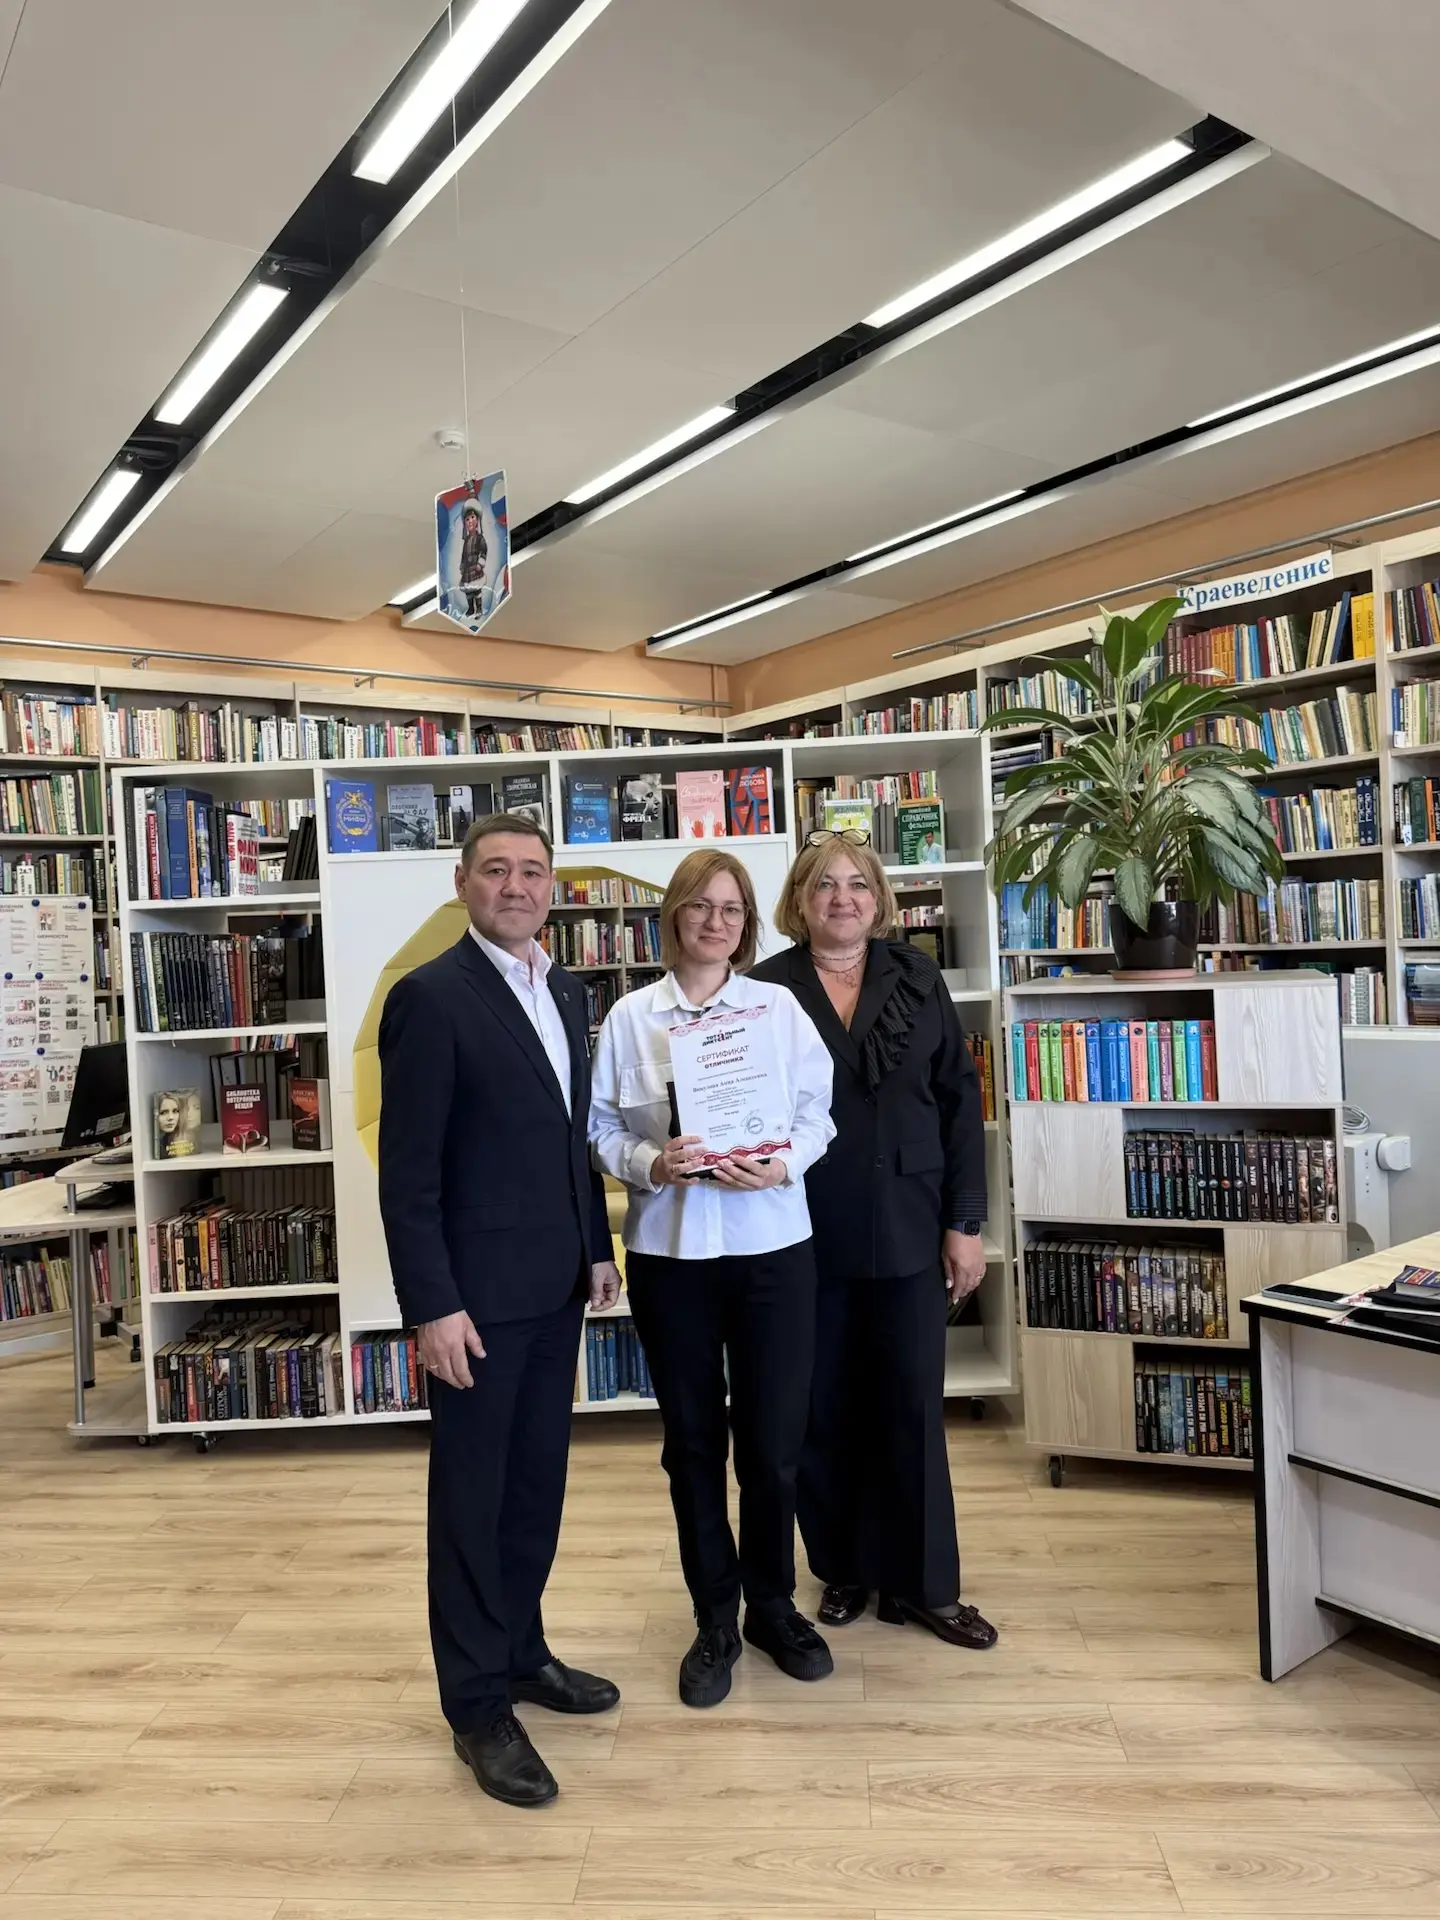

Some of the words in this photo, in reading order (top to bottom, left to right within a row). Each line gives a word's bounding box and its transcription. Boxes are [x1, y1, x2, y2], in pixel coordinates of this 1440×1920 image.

[1179, 557, 1331, 611] Краеведение
[902, 813, 938, 822] СПРАВОЧНИК
[237, 839, 257, 856] ФЛАГИ
[239, 856, 257, 876] МИРА
[697, 1045, 750, 1063] СЕРТИФИКАТ
[704, 1056, 744, 1069] отличника
[226, 1089, 260, 1097] БИБЛИОТЕКА
[226, 1096, 261, 1104] ПОТЕРЯННЫХ
[1186, 1397, 1194, 1417] БРЕСТА
[1197, 1392, 1205, 1412] БРЕСТА
